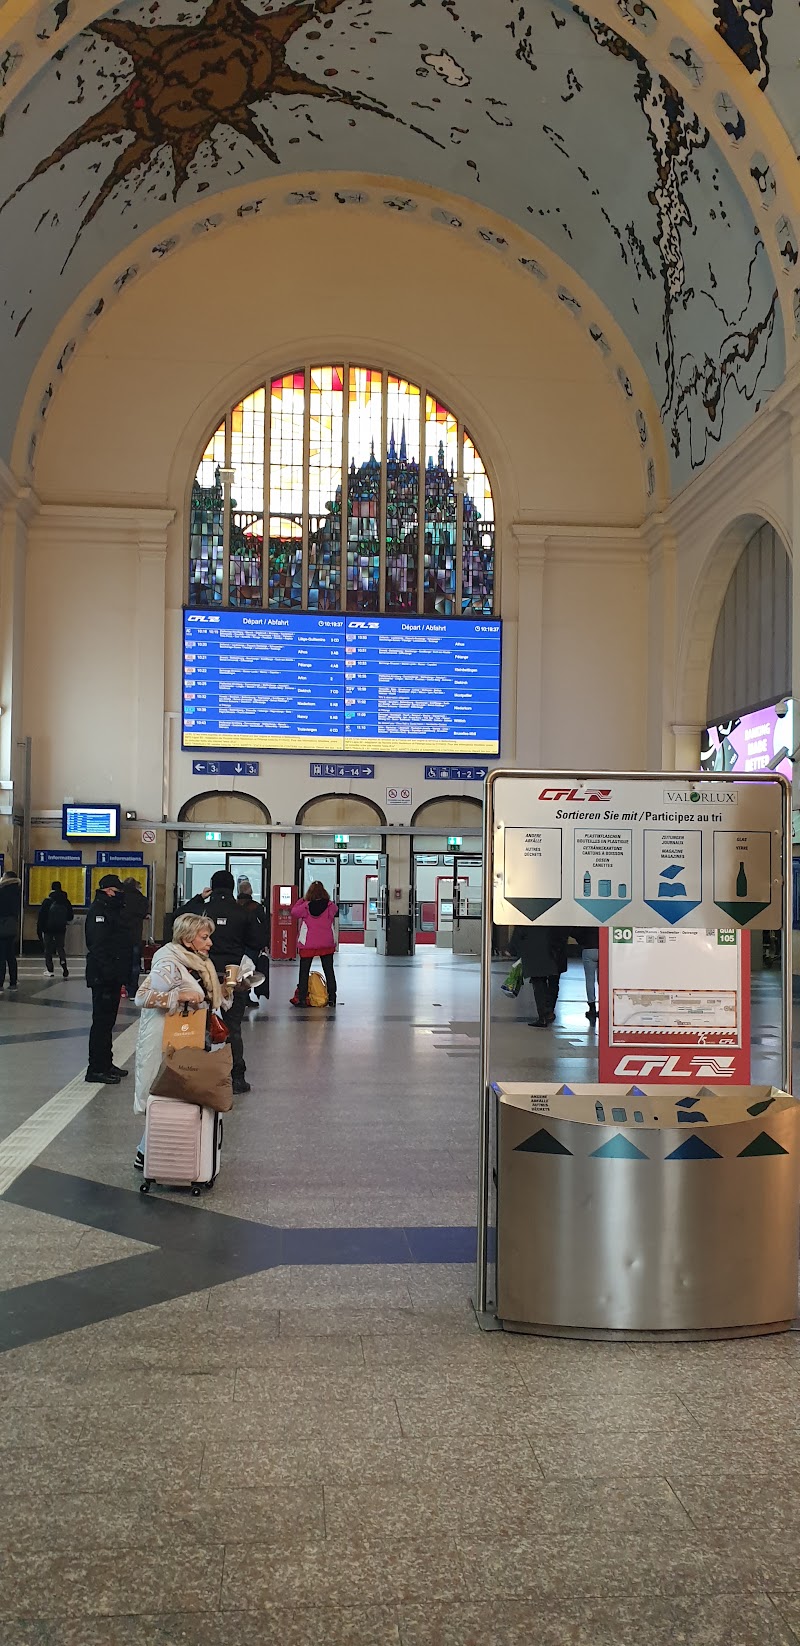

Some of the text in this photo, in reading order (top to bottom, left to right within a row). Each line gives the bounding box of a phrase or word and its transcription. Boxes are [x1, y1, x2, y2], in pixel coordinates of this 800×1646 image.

[538, 788, 586, 801] CFL
[666, 791, 735, 803] VALORLUX
[556, 810, 600, 820] Sortieren
[604, 811, 619, 820] Sie
[622, 811, 637, 821] mit
[646, 812, 694, 824] Participez
[712, 813, 722, 822] tri
[614, 929, 632, 940] 30
[614, 1055, 692, 1076] CFL
